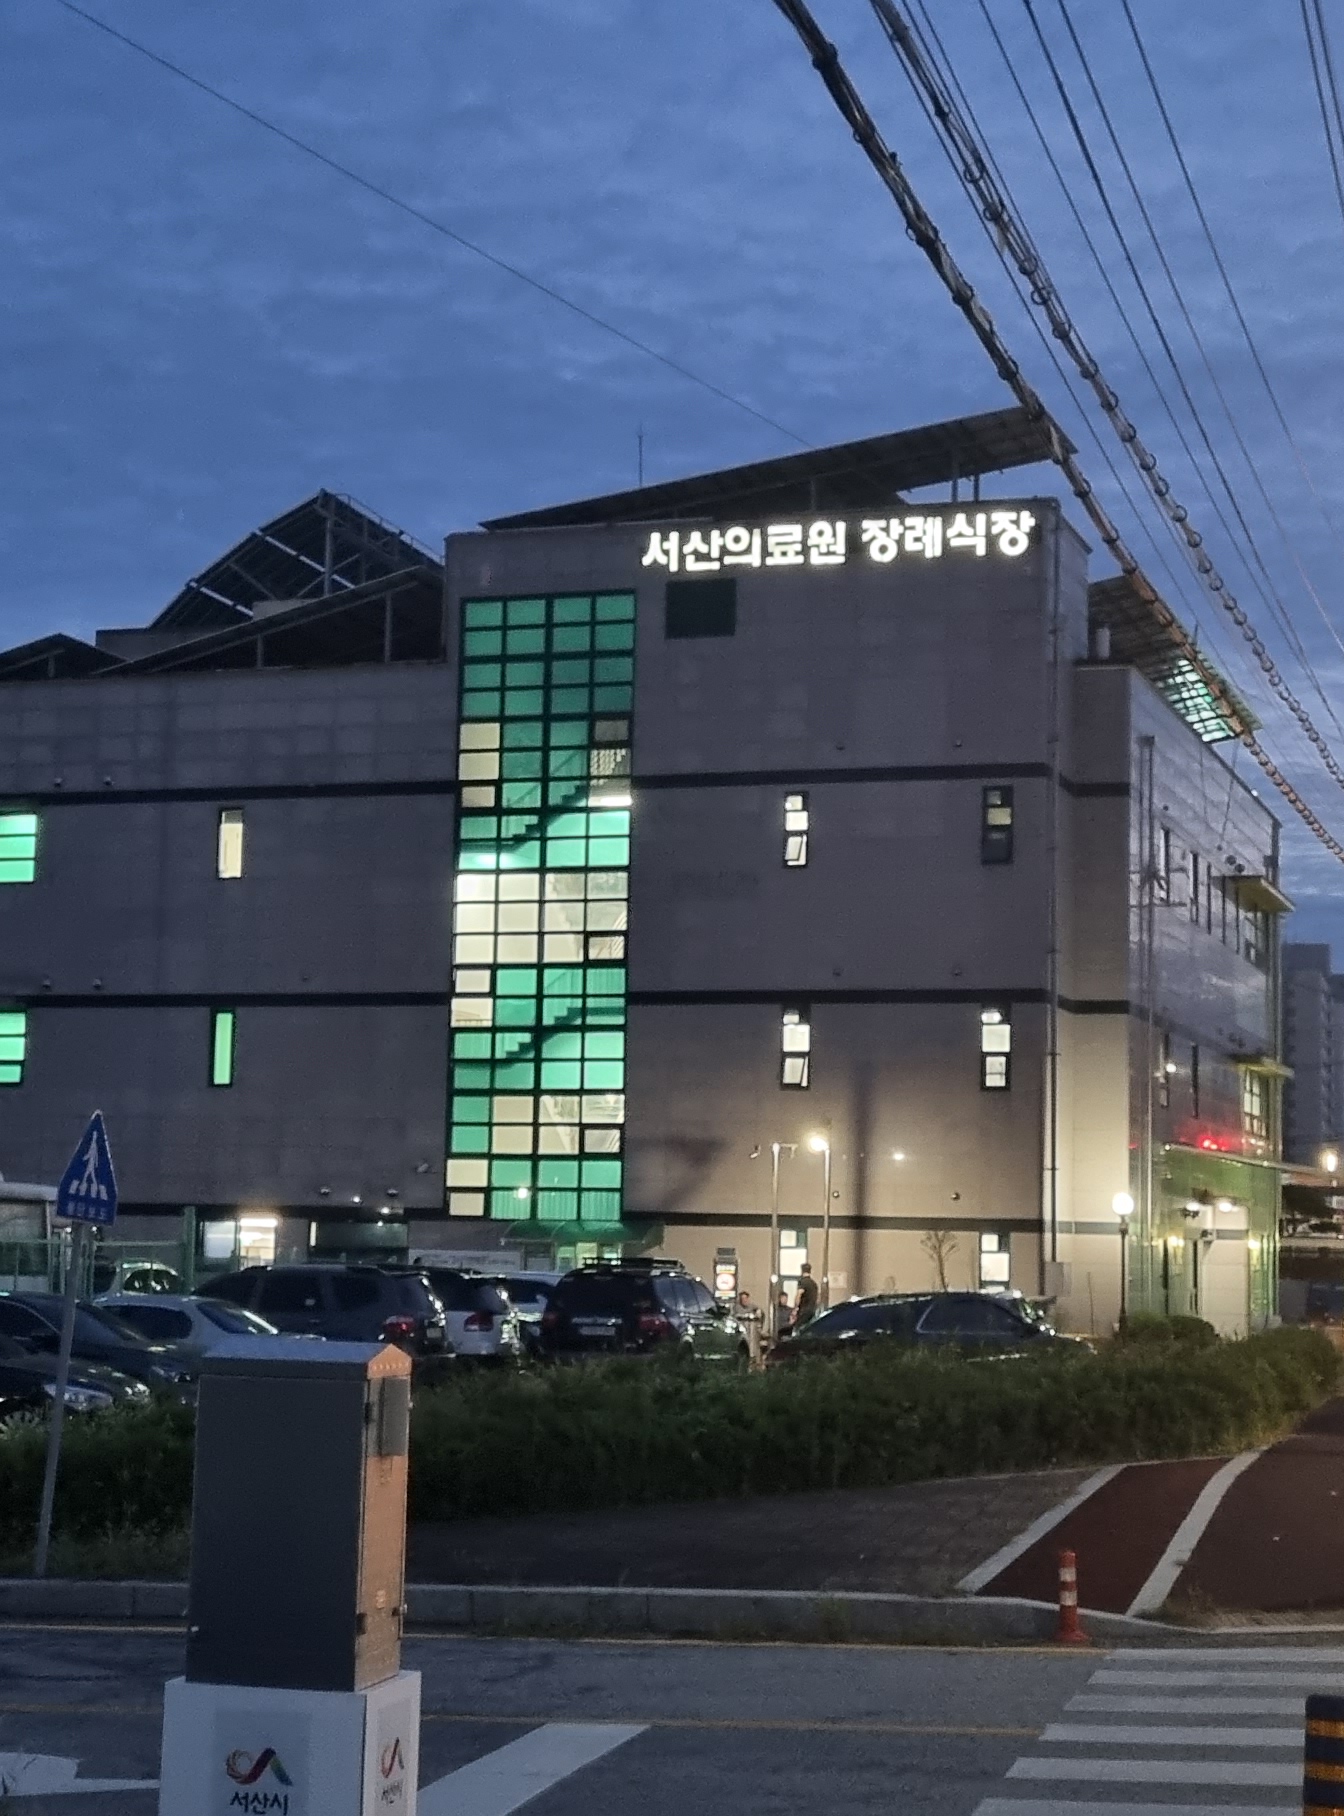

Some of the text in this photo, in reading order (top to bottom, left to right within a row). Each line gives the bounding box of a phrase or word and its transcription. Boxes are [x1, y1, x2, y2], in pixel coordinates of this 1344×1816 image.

[641, 510, 1037, 573] 서산의료원 장례식장
[229, 1791, 289, 1816] 서산시
